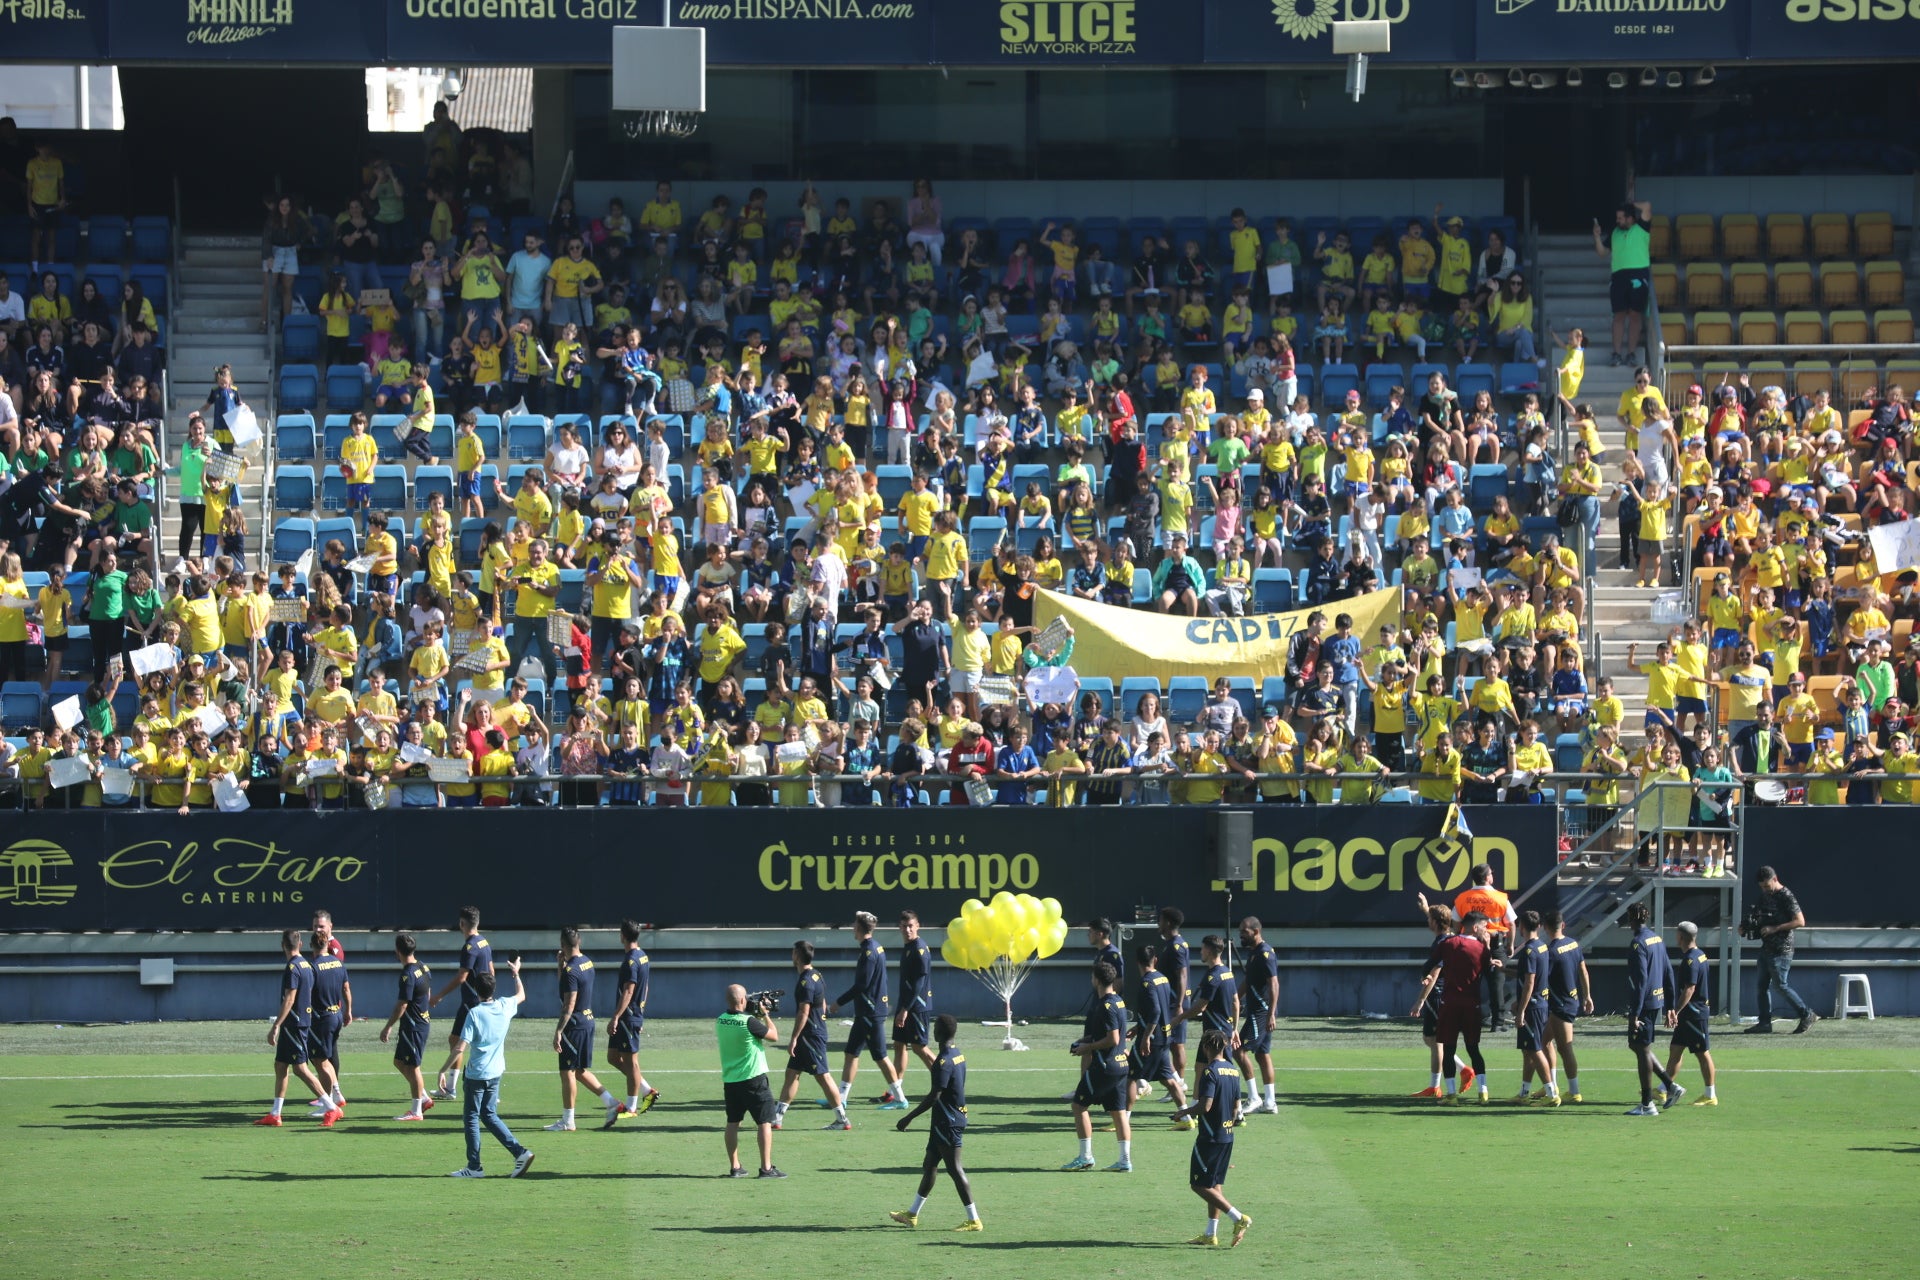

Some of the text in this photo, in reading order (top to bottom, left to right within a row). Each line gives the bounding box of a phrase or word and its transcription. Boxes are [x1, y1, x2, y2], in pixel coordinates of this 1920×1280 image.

[187, 0, 293, 24] MANILA
[1000, 2, 1136, 43] SLICE
[1614, 25, 1674, 34] DESDE 1821
[186, 26, 276, 44] Multibar
[1001, 43, 1136, 54] NEW YORK PIZZA
[832, 834, 966, 846] DESDE 1904
[98, 838, 368, 889] El Faro
[758, 840, 1040, 898] Cruzcampo
[181, 890, 304, 905] CATERING
